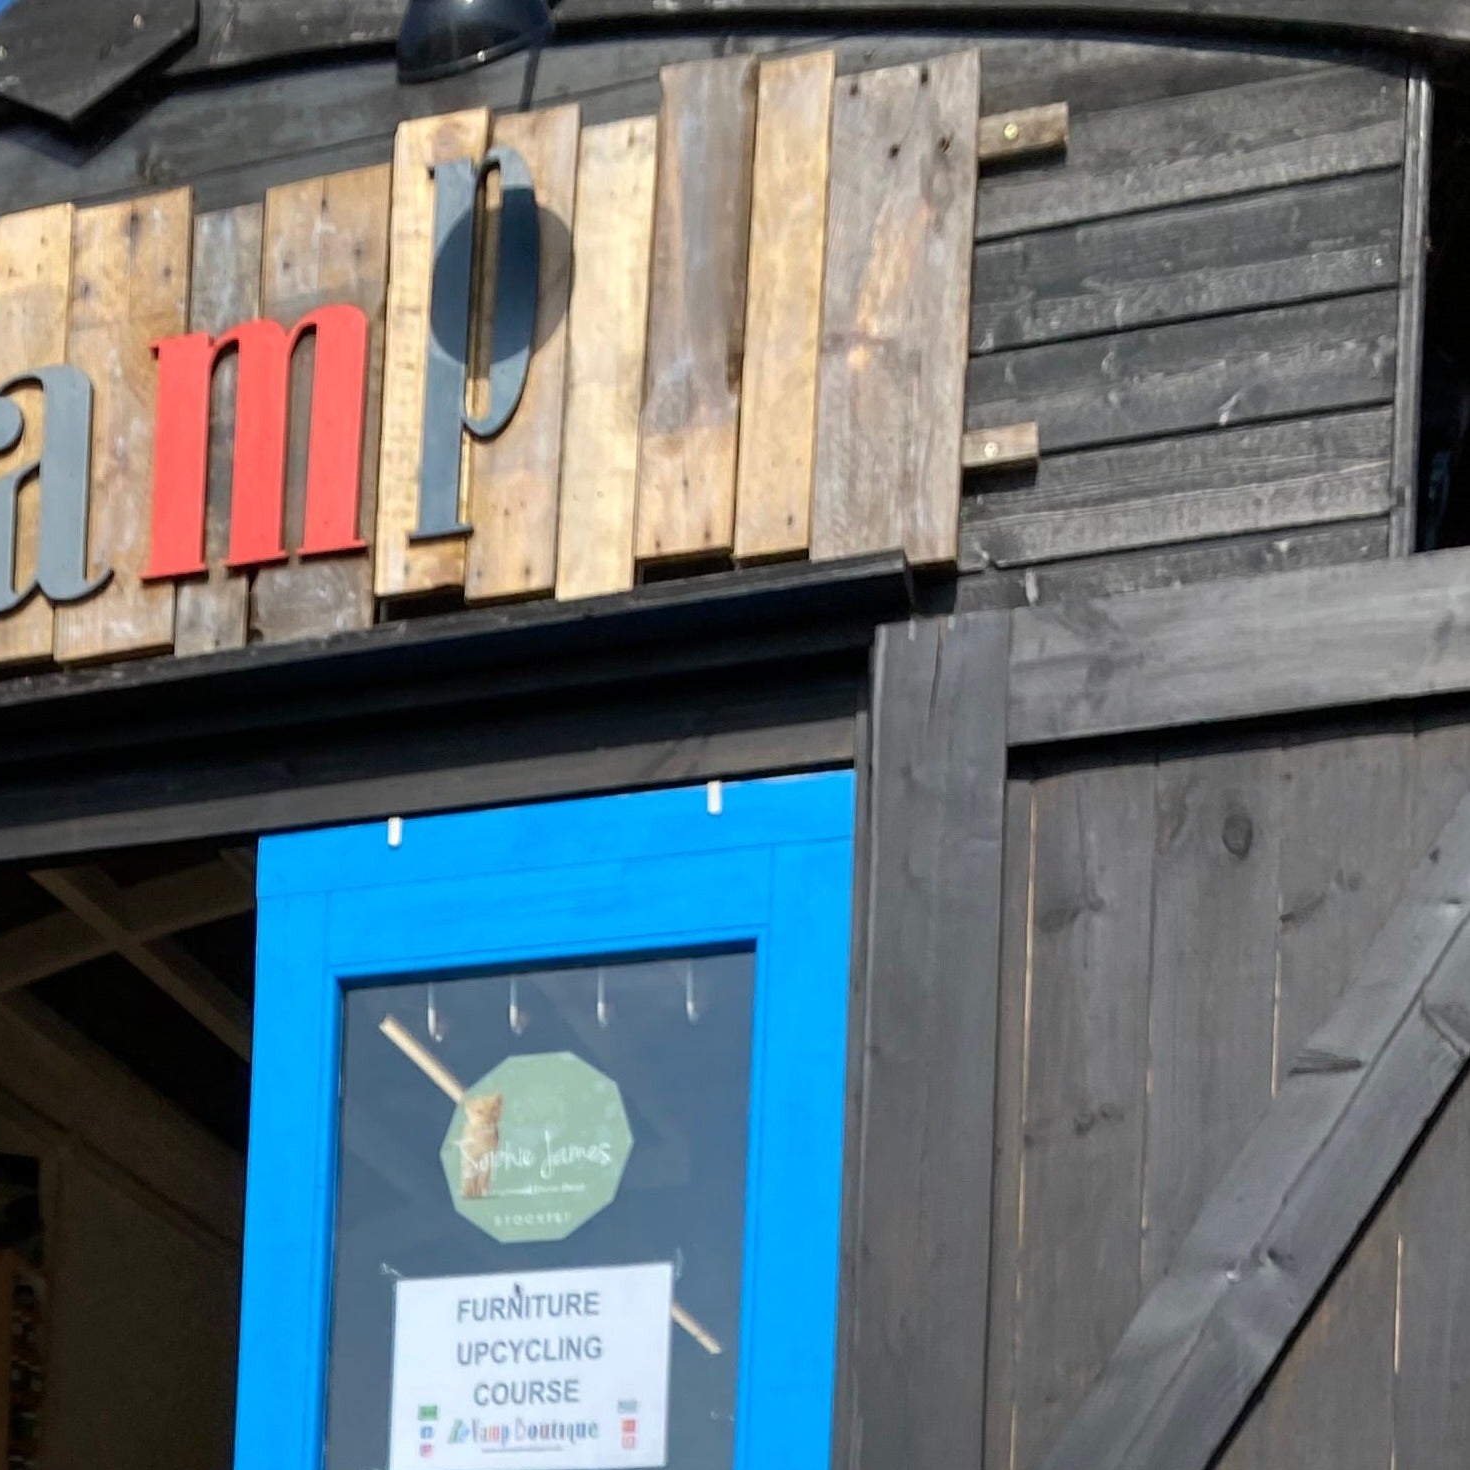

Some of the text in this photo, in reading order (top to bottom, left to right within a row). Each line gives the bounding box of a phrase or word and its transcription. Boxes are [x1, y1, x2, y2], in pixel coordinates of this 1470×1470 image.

[456, 1292, 600, 1322] FURNITURE
[456, 1336, 603, 1365] UPCYCLING
[473, 1379, 580, 1406] COURSE
